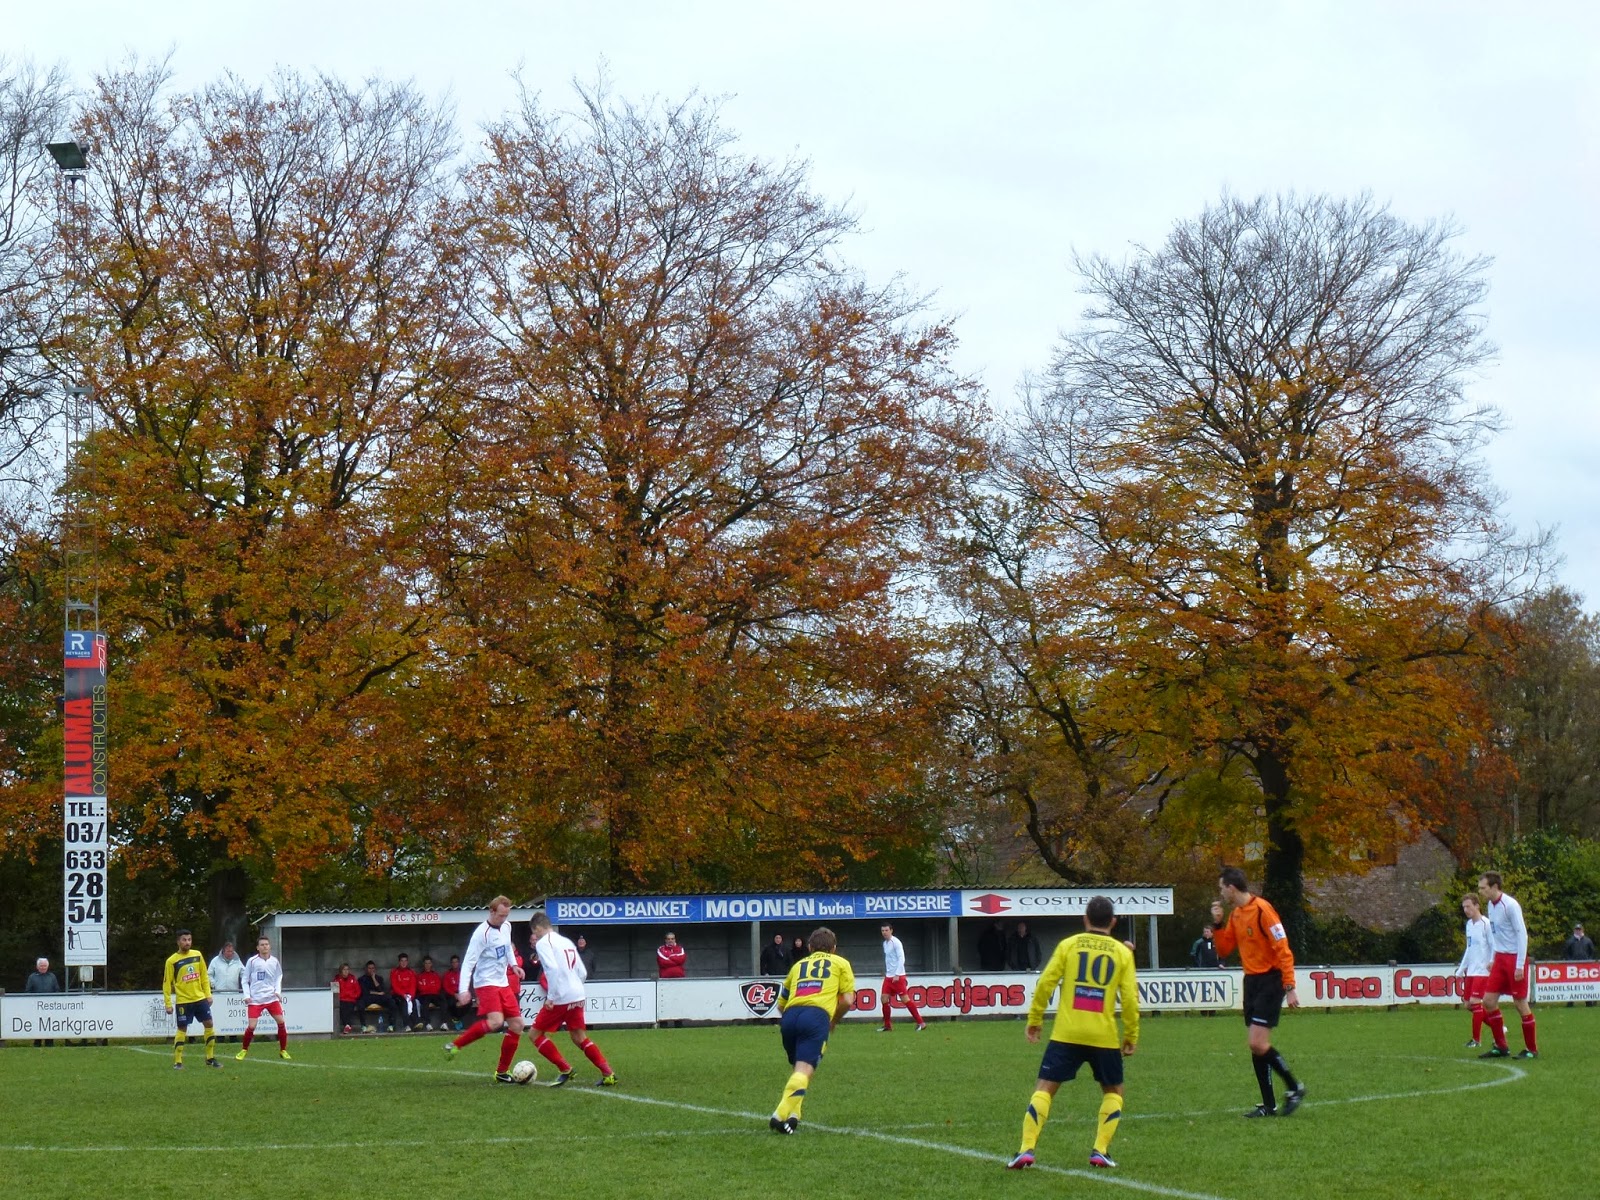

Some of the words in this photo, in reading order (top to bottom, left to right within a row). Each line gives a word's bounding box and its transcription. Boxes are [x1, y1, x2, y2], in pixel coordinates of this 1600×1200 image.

[65, 698, 92, 795] ALUMA
[93, 684, 106, 795] CONSTRUCTIES
[66, 822, 105, 843] 03/
[66, 850, 105, 870] 633
[68, 872, 104, 898] 28
[558, 902, 616, 918] BROOD
[624, 901, 690, 917] BANKET
[706, 898, 815, 918] MOONEN
[818, 902, 854, 915] bvba
[865, 895, 951, 912] PATISSERIE
[1019, 895, 1170, 906] COSTEMANS
[68, 899, 103, 924] 54
[564, 949, 577, 970] 17
[797, 959, 832, 980] 18
[1075, 951, 1115, 986] 10
[1538, 966, 1561, 980] De
[1566, 965, 1600, 979] Bac
[1138, 980, 1227, 1004] NSERVEN
[1310, 970, 1382, 1000] Theo
[37, 1001, 84, 1010] Restaurant
[1570, 992, 1600, 1000] ANTONIU
[229, 1009, 247, 1017] 2018
[12, 1017, 33, 1032] De
[38, 1016, 114, 1035] Markgrave
